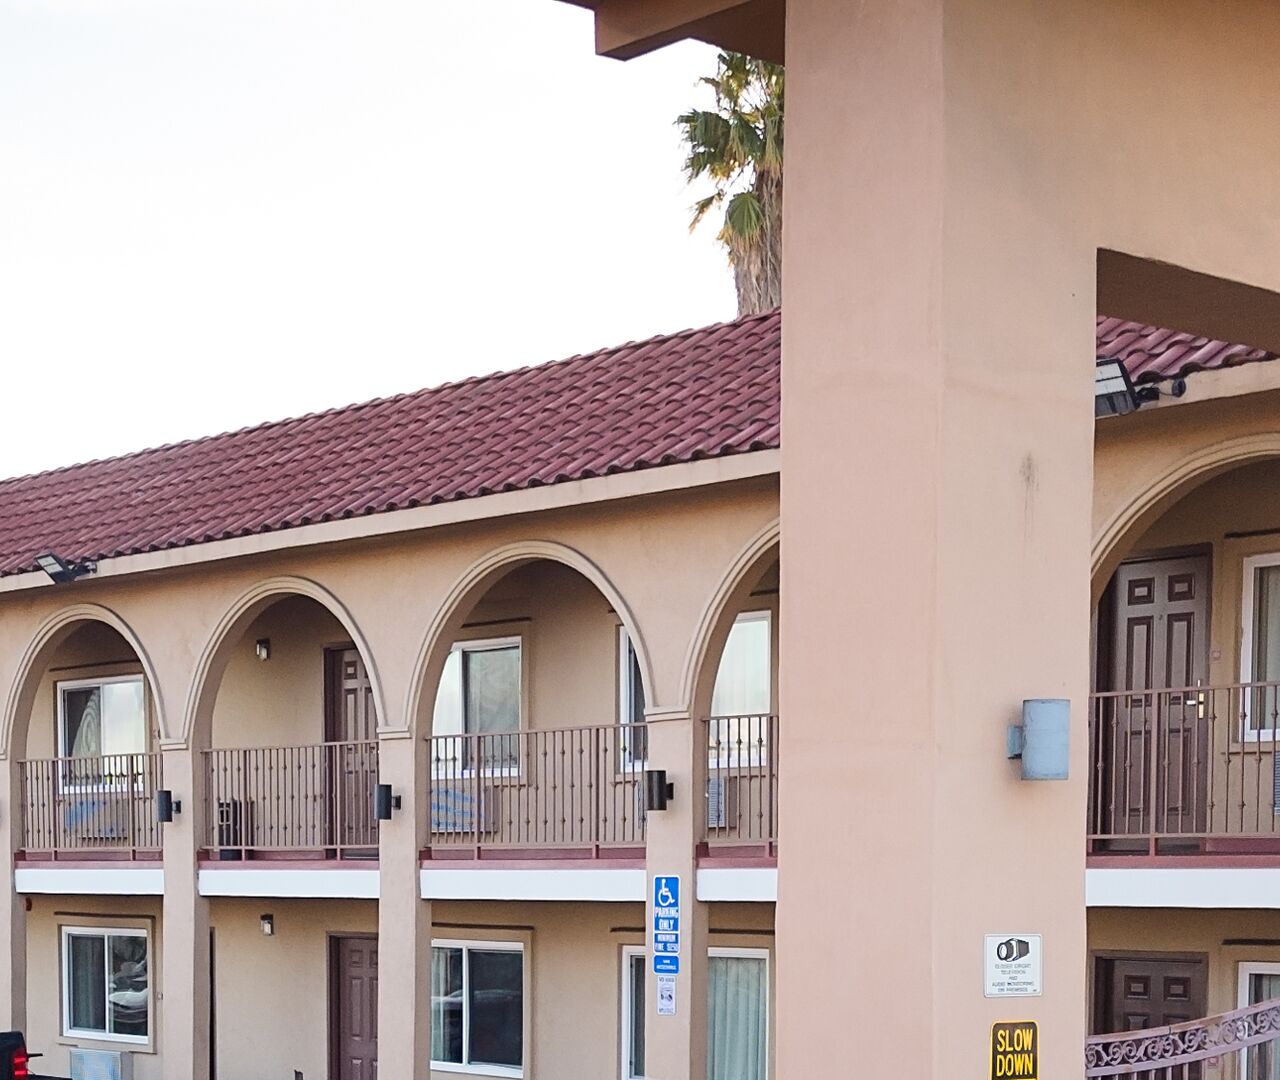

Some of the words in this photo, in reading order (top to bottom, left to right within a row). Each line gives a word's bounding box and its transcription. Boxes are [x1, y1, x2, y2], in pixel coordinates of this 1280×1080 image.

[655, 906, 678, 918] PARKING
[658, 918, 674, 930] ONLY
[996, 1028, 1033, 1052] SLOW
[996, 1052, 1033, 1077] DOWN
